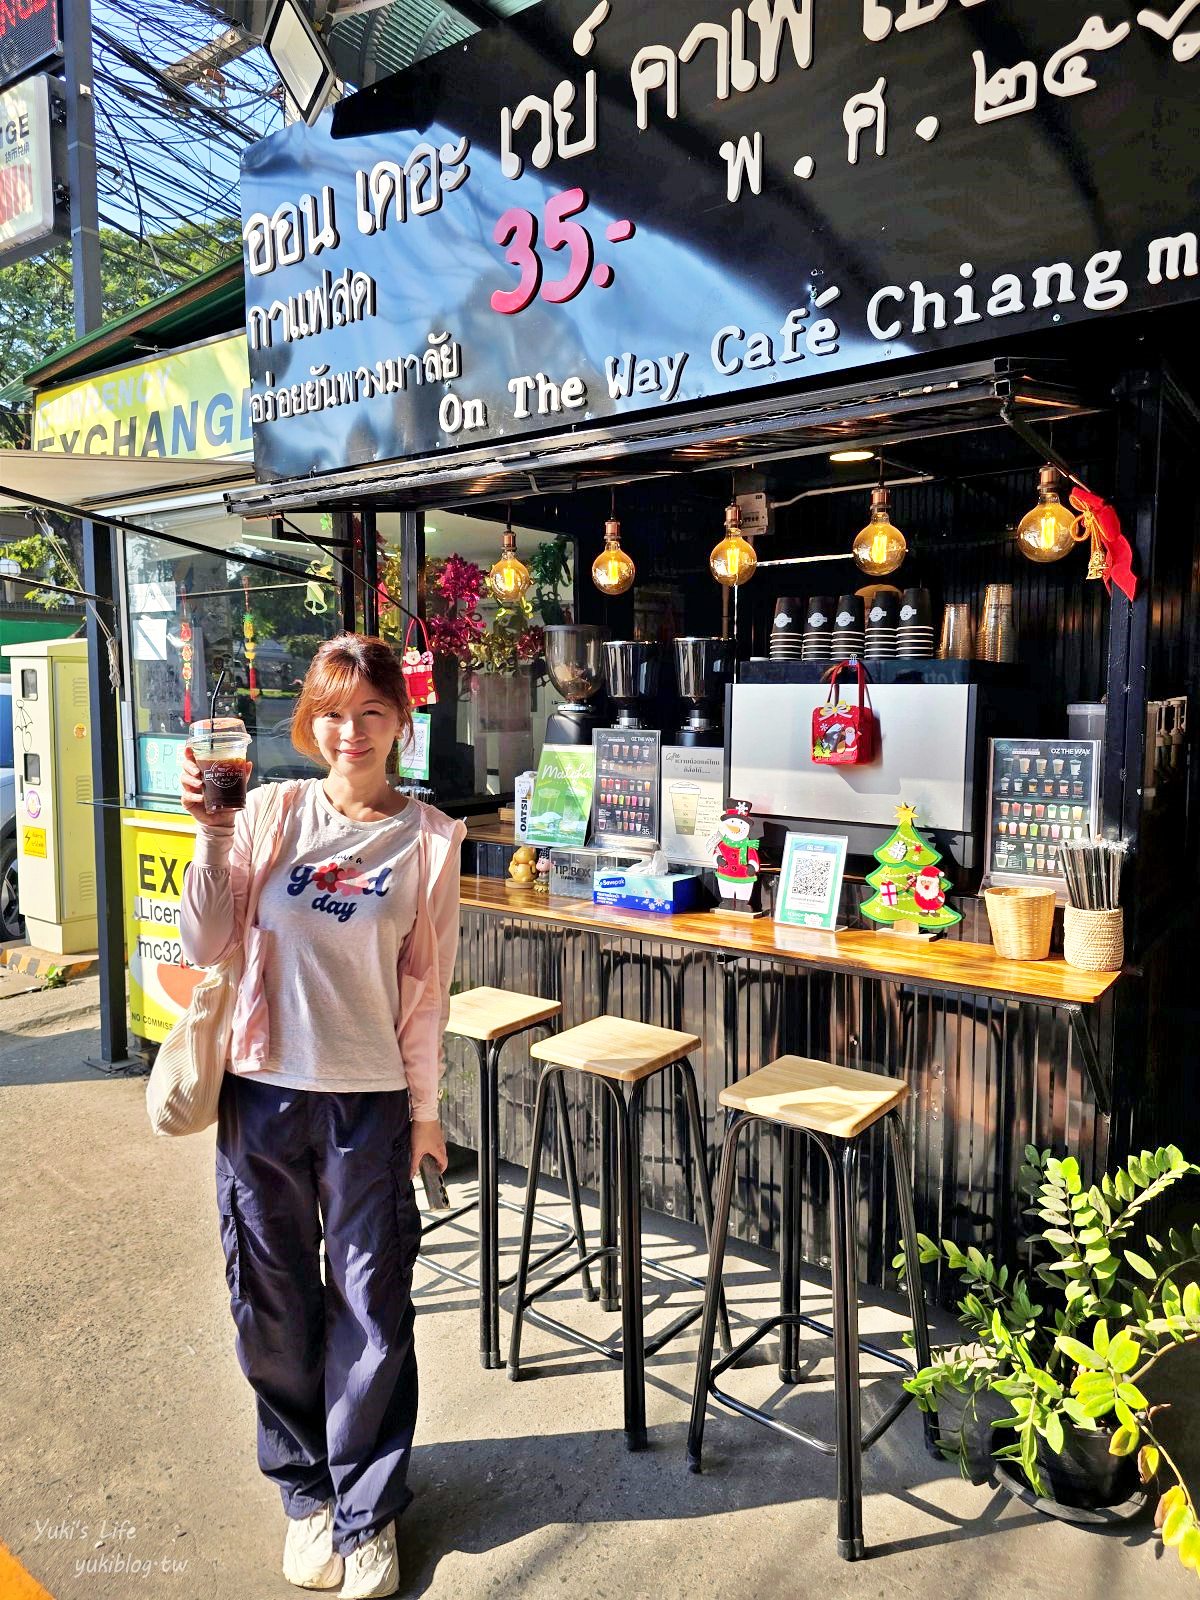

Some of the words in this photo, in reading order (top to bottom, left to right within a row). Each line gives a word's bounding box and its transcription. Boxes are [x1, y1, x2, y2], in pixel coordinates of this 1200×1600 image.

[243, 186, 341, 276] ออน
[355, 136, 471, 236] เดอะ
[248, 268, 376, 350] กาแฟสด
[438, 392, 488, 434] On
[508, 371, 588, 420] The
[604, 351, 690, 402] Way
[710, 285, 841, 376] Café
[866, 249, 1130, 341] Chiang
[541, 763, 593, 781] Matcha
[138, 852, 187, 897] EX
[554, 864, 569, 875] TIP
[570, 866, 591, 878] BOX
[139, 896, 182, 925] Licen
[311, 893, 358, 923] day
[137, 938, 182, 965] mc32
